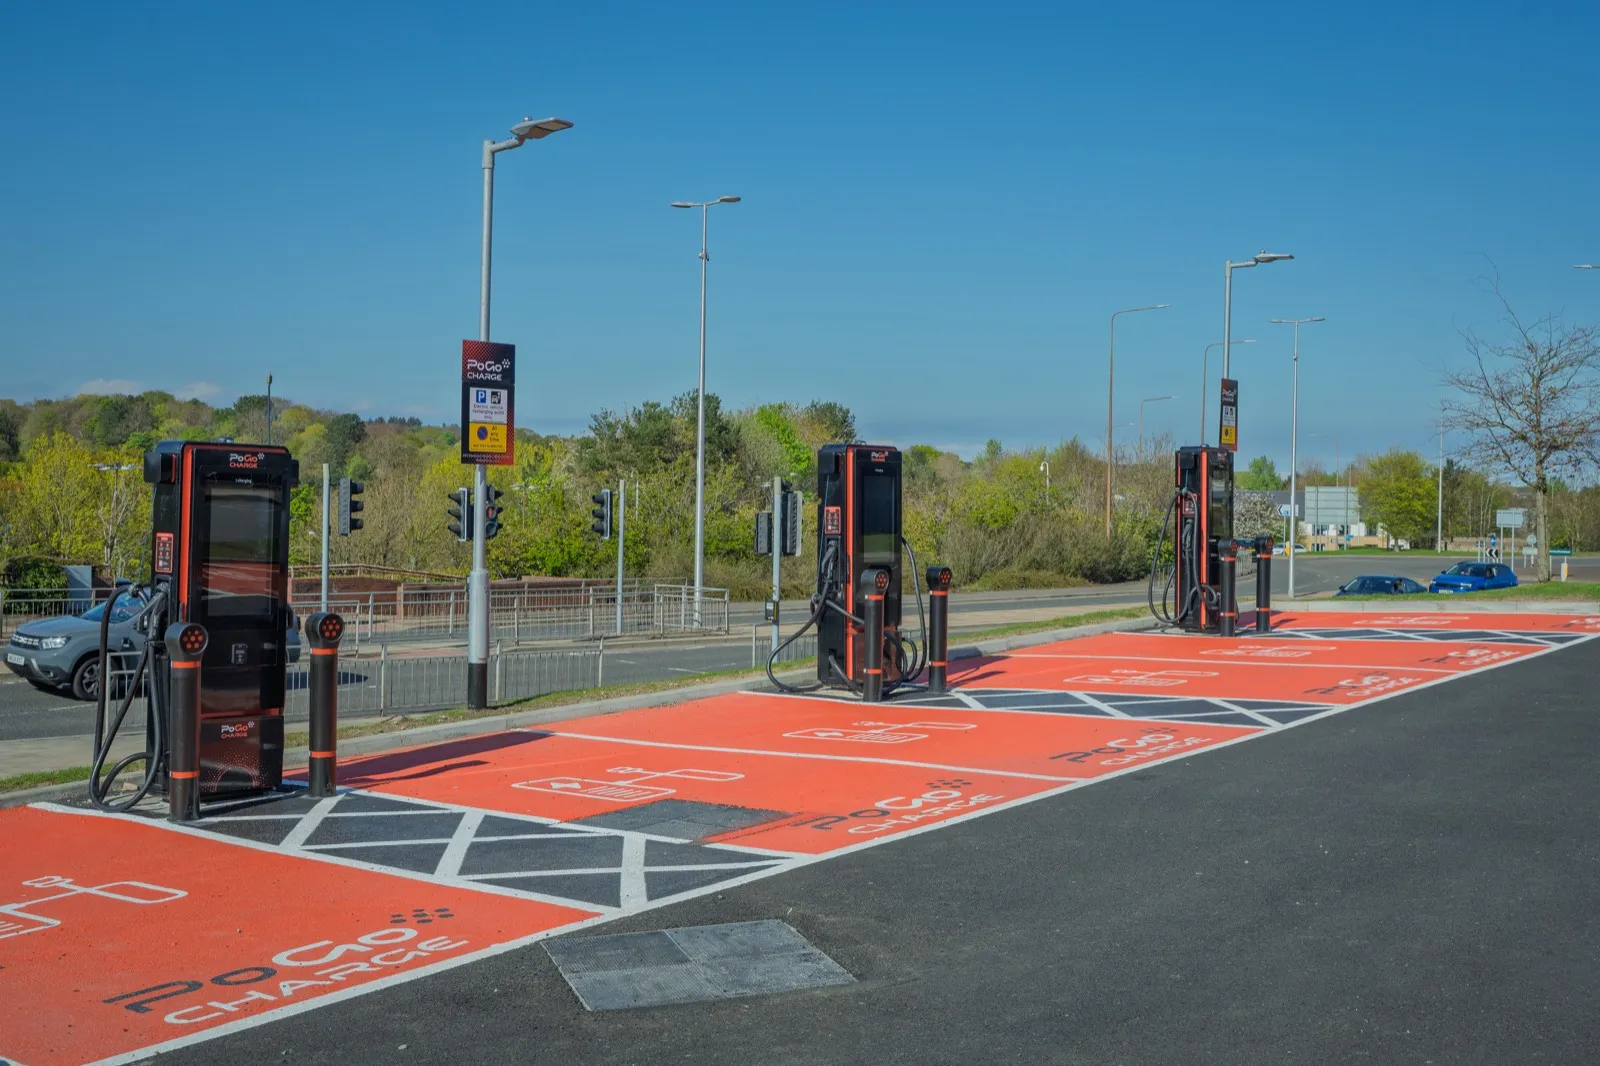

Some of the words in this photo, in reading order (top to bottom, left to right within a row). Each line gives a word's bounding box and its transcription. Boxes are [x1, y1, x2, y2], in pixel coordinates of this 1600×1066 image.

[467, 359, 502, 372] PoGo
[467, 372, 502, 381] CHARGE
[230, 453, 258, 462] PoGo
[221, 723, 248, 733] PoGo
[848, 794, 1005, 834] CHARGE
[164, 935, 468, 1024] CHARGE
